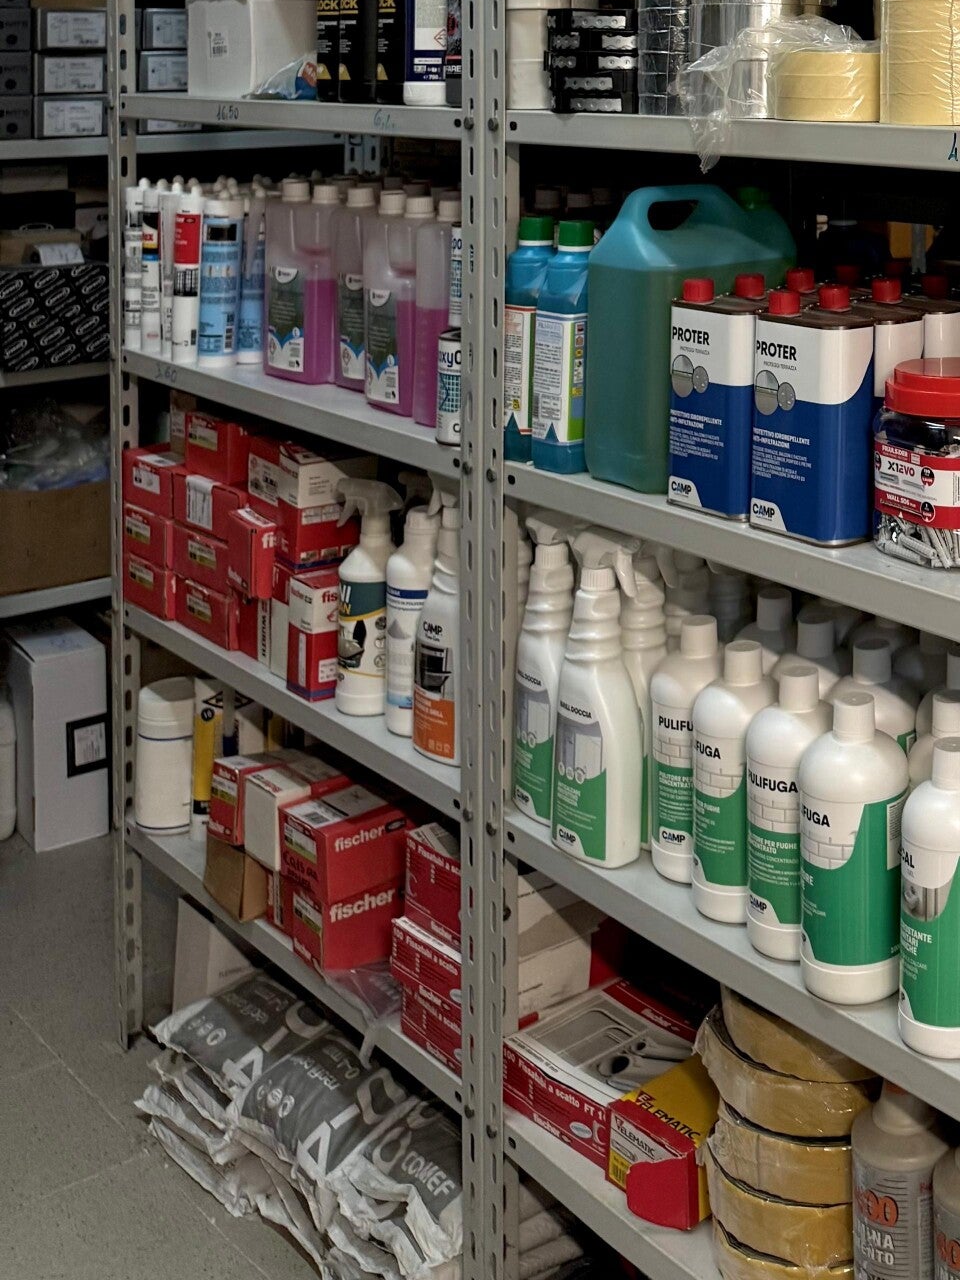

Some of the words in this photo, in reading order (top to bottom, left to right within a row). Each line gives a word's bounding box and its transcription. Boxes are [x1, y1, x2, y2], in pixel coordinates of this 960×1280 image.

[672, 326, 710, 346] PROTER
[756, 339, 797, 361] PROTER
[887, 460, 915, 477] X1EVO
[671, 481, 692, 495] CAMP
[752, 503, 776, 518] CAMP
[424, 621, 443, 637] CAMP
[571, 707, 592, 719] DOCCIA
[658, 715, 693, 732] PULIFU
[334, 824, 385, 852] fischer
[662, 829, 686, 844] CAMP
[329, 888, 396, 924] fischer
[556, 1087, 580, 1108] scatto
